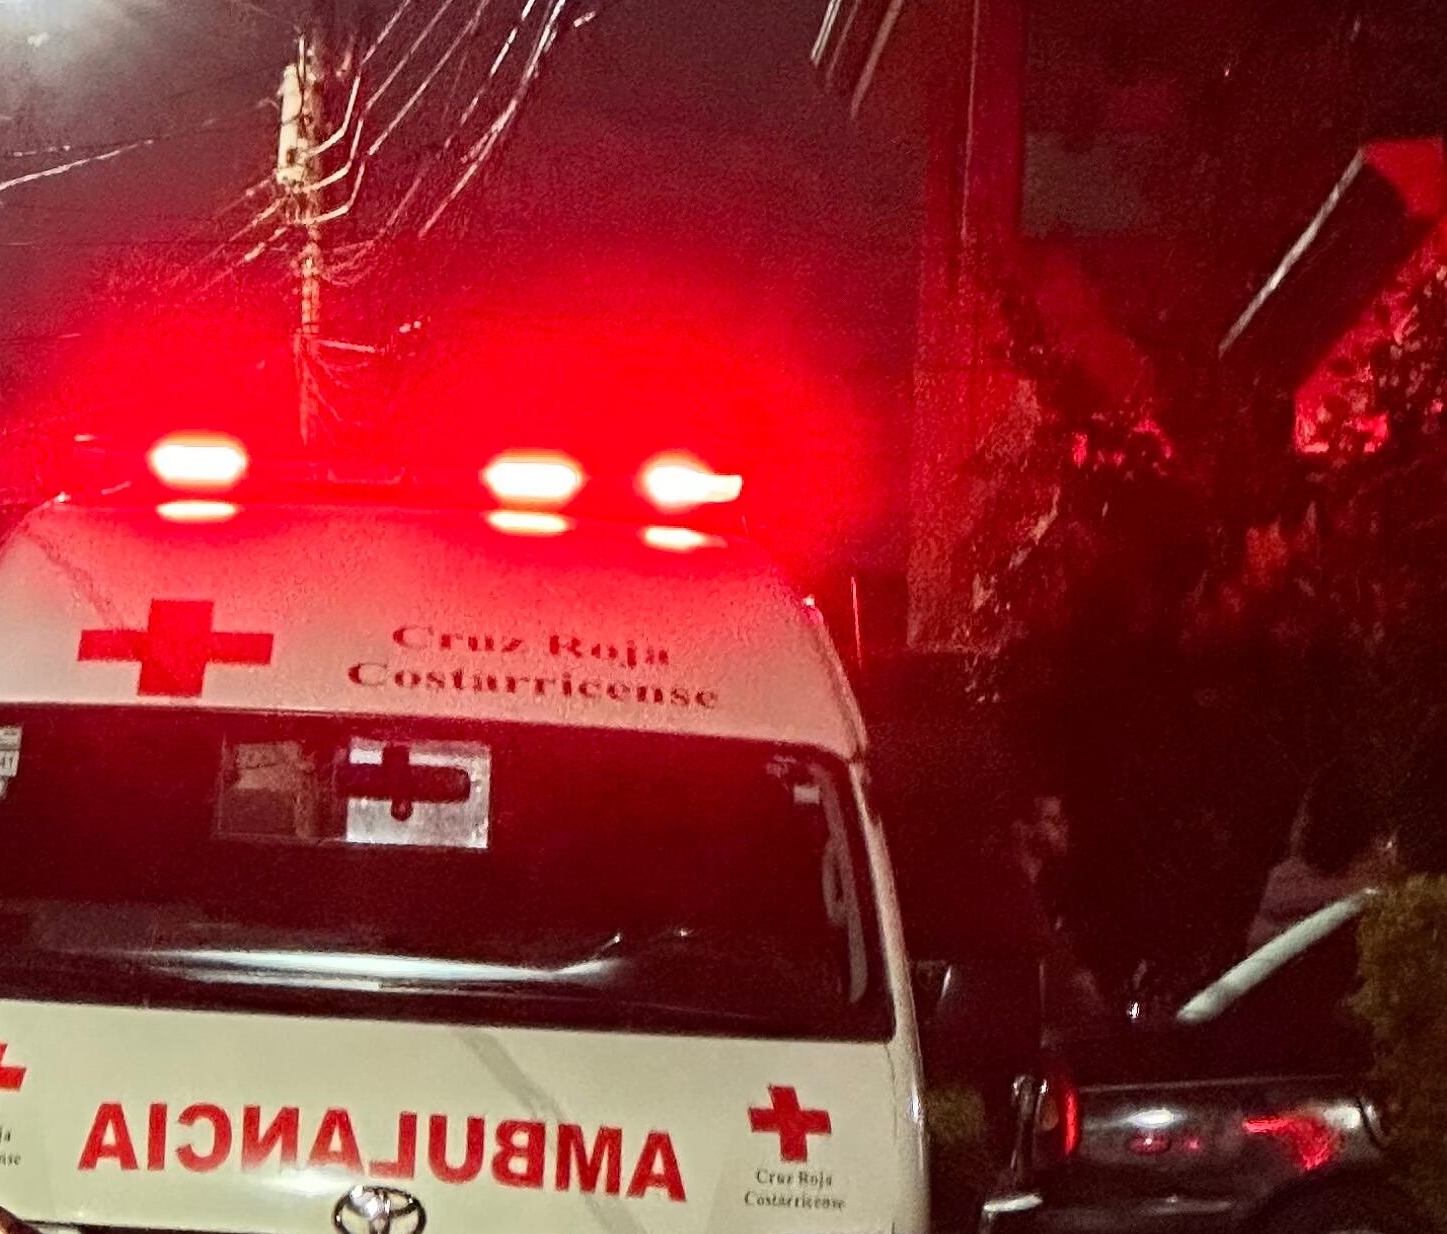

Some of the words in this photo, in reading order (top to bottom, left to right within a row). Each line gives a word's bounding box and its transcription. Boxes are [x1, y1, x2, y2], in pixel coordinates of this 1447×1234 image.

[392, 624, 526, 654] Cruz
[548, 633, 670, 670] Roja
[347, 660, 719, 710] Costarricense
[756, 1167, 794, 1185] Cruz
[798, 1170, 833, 1189] Roja
